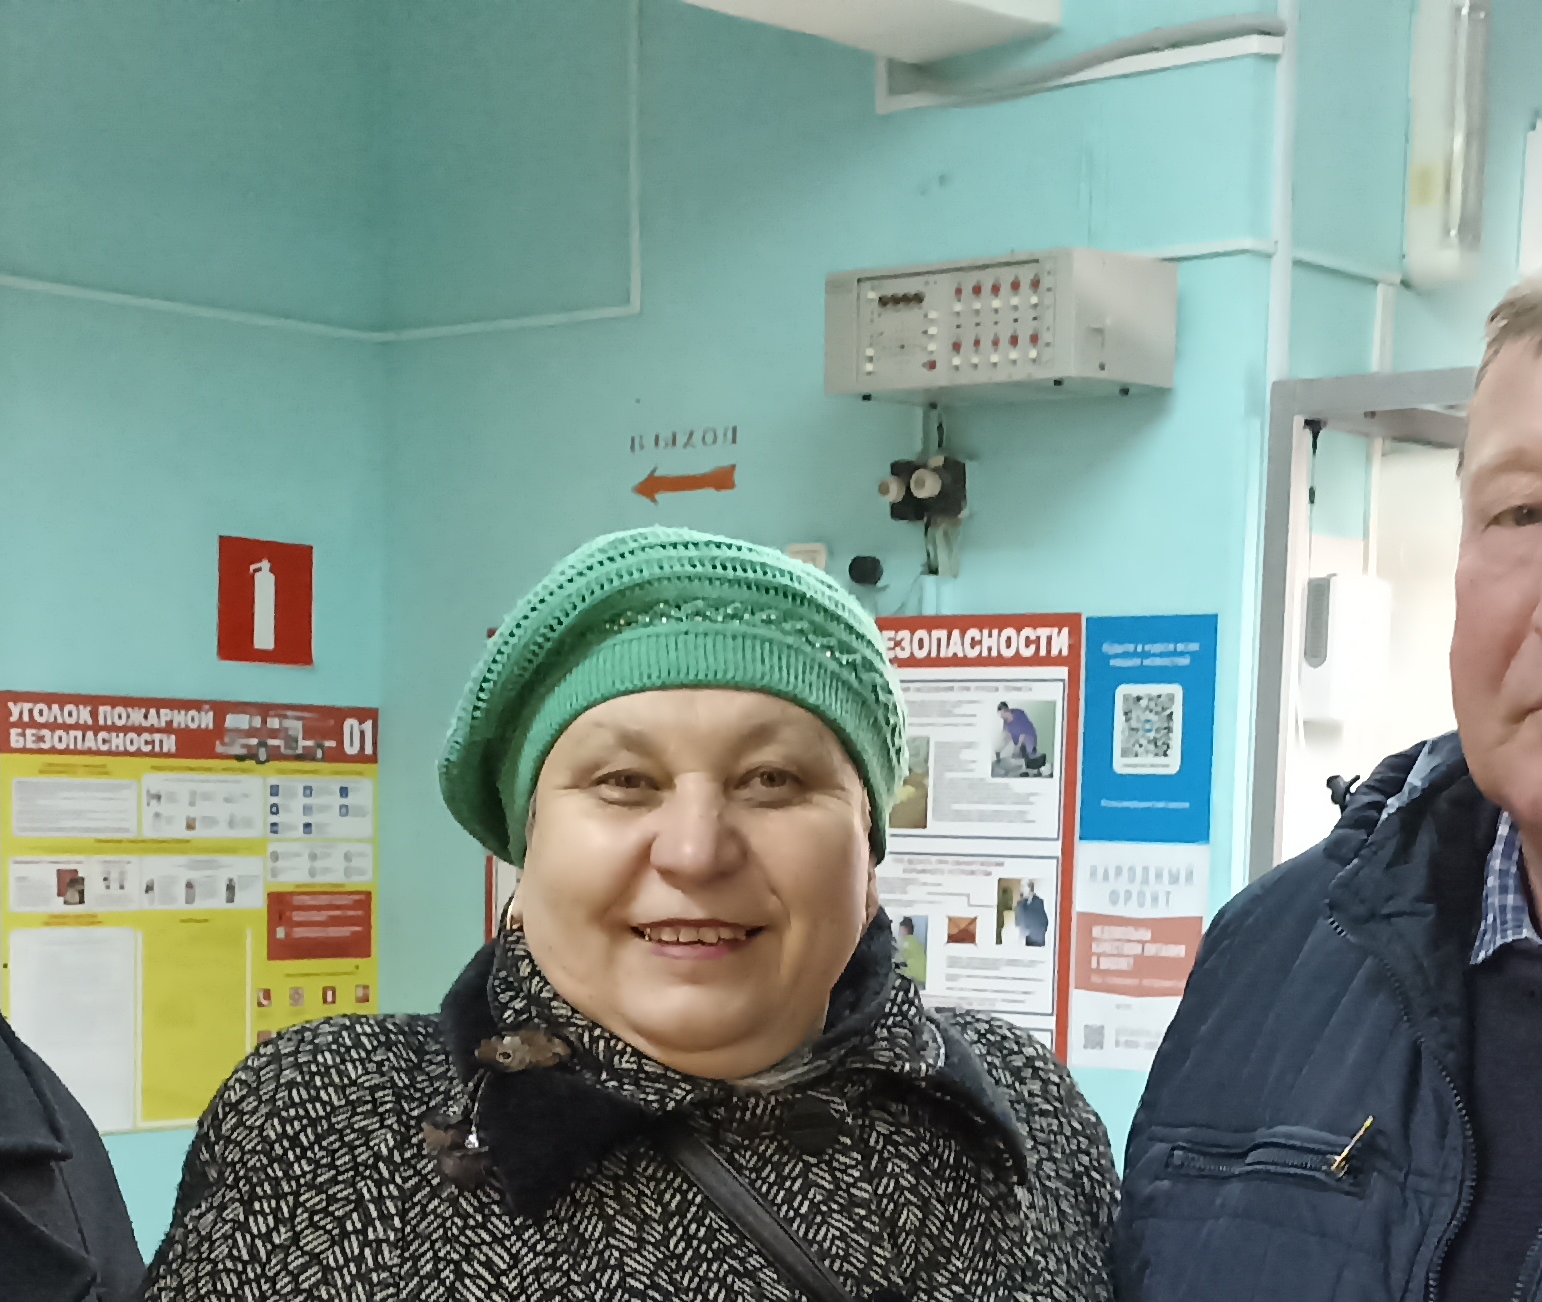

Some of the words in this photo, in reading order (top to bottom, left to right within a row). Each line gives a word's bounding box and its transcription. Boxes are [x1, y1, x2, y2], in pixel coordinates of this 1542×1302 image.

[8, 702, 92, 726] УГОЛОК
[98, 704, 214, 730] ПОЖАРНОЙ
[9, 728, 176, 753] БЕЗОПАСНОСТИ
[343, 718, 373, 755] 01
